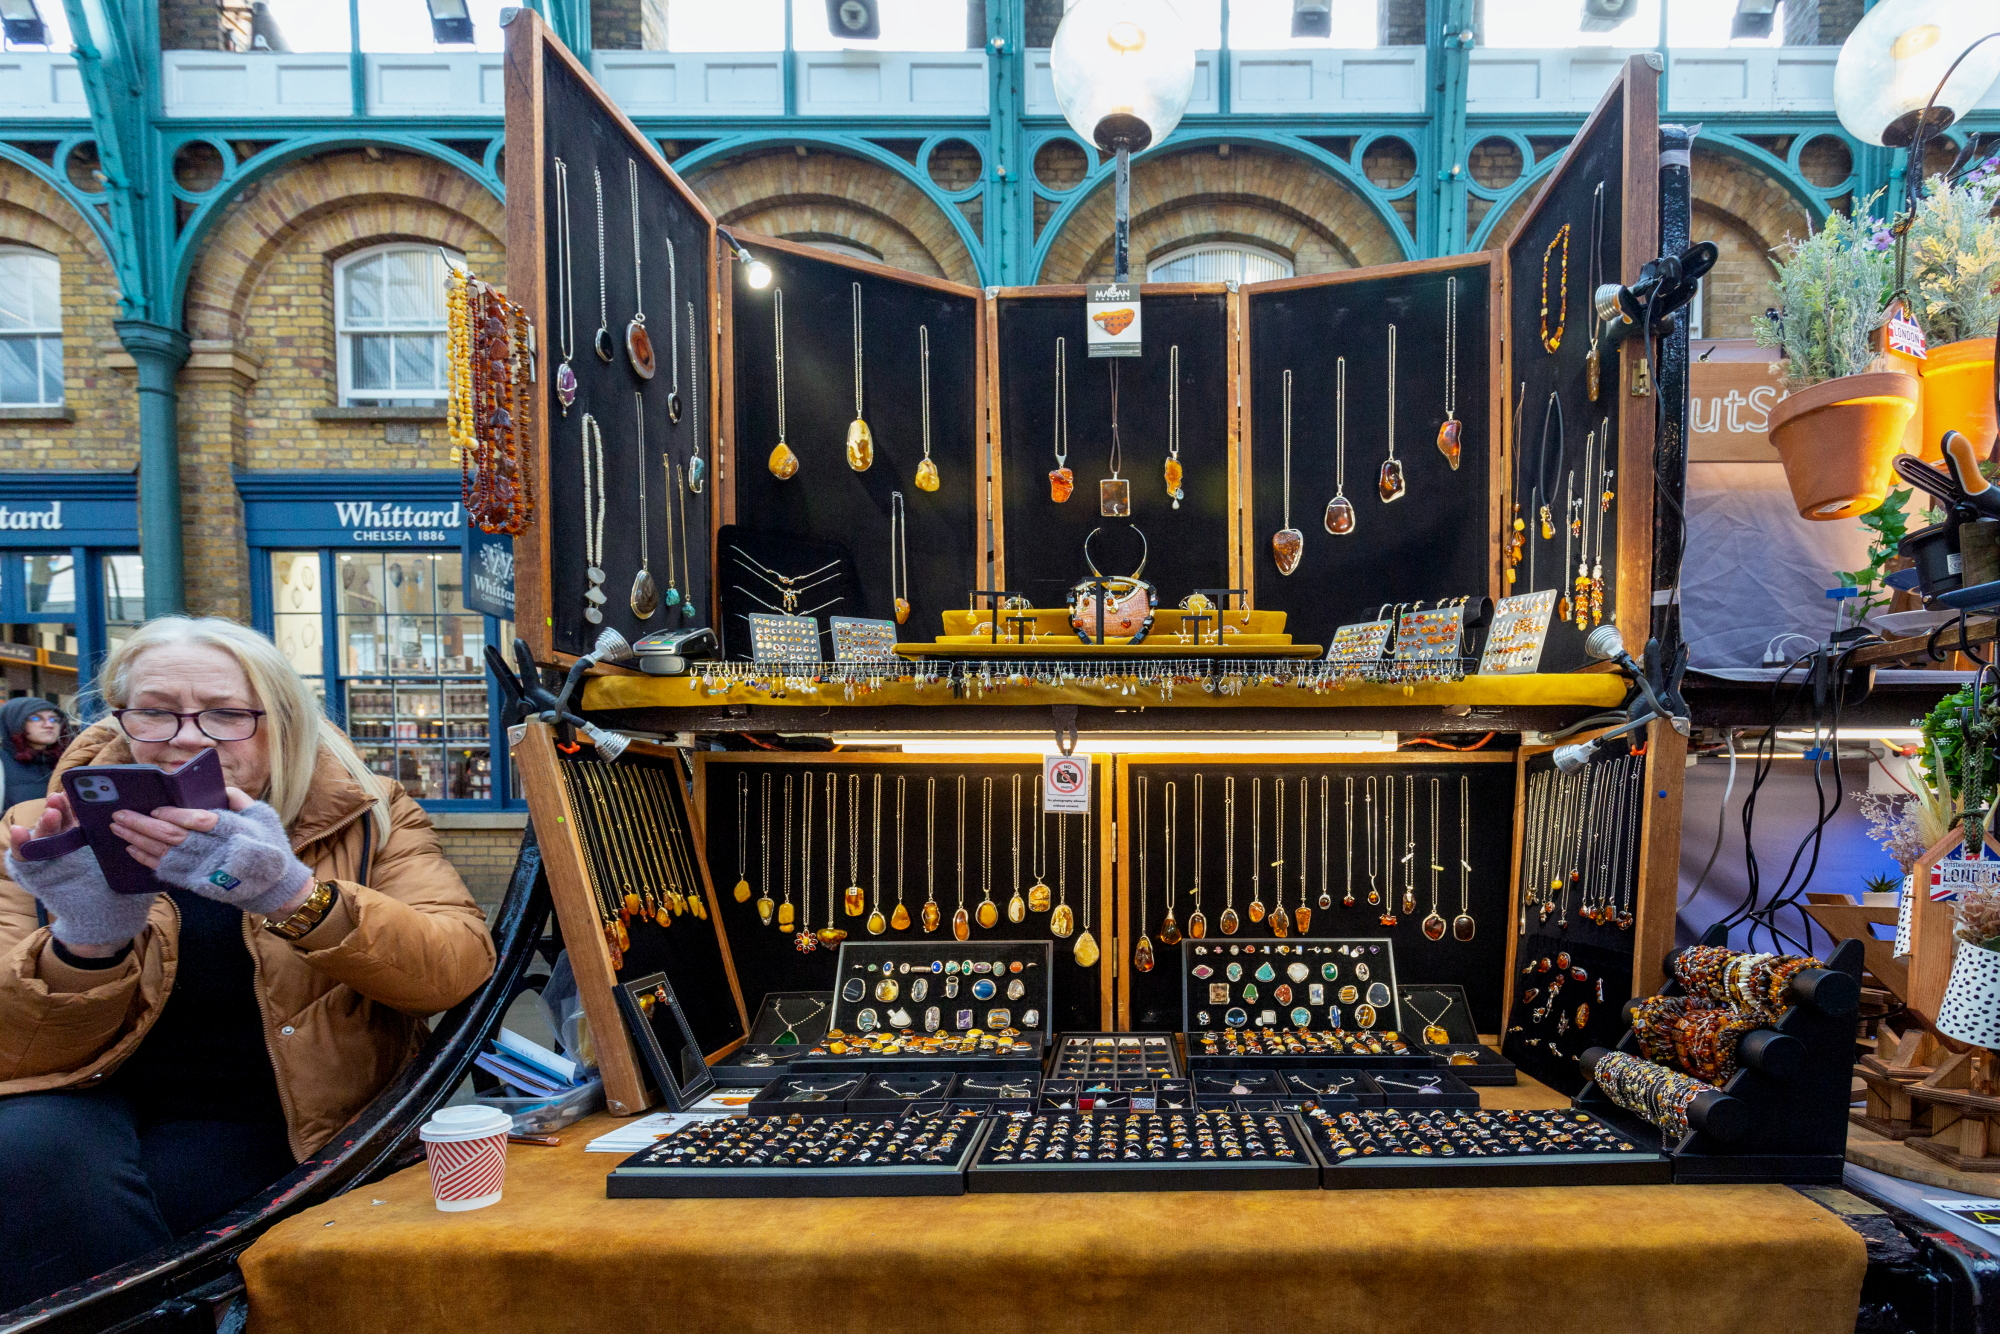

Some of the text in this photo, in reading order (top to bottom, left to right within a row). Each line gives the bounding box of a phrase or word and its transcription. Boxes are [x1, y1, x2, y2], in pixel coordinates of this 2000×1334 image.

[1894, 326, 1919, 344] LONDON
[334, 501, 461, 528] Whittard
[353, 530, 446, 541] CHELSEA 1886
